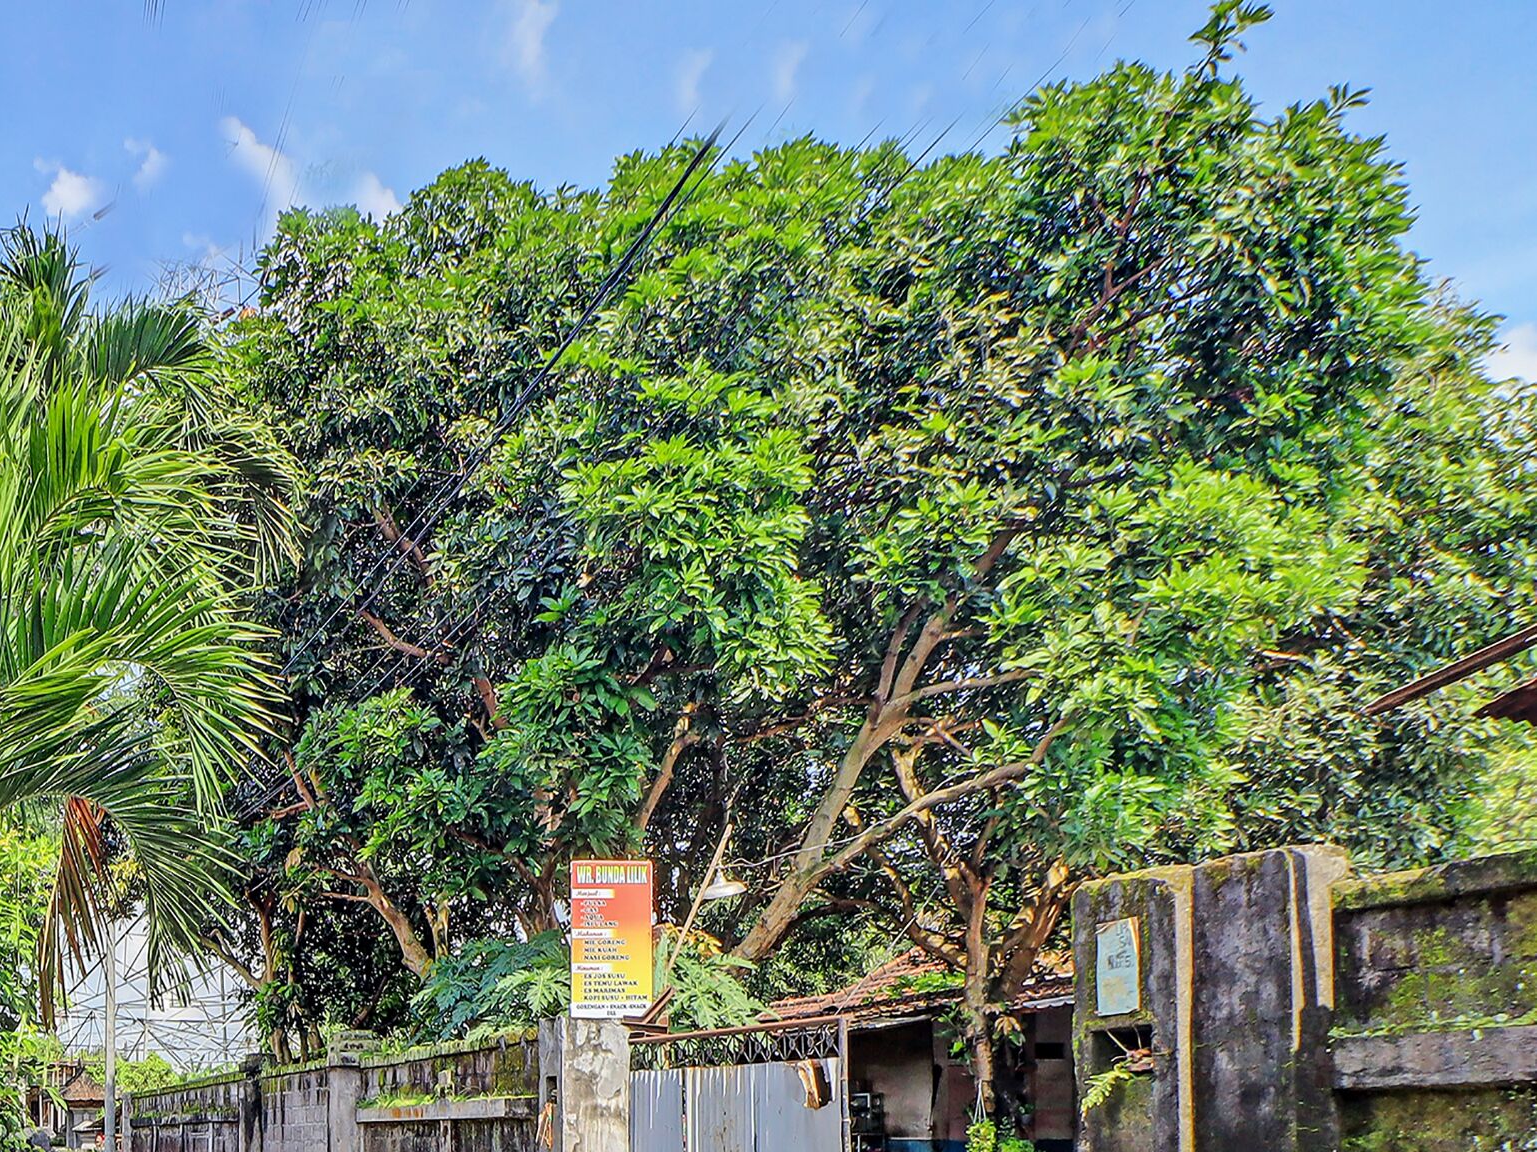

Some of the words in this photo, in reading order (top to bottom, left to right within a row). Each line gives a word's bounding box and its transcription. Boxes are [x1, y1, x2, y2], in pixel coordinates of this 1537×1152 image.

[576, 865, 594, 884] WR.
[595, 865, 625, 884] BUNDA
[626, 865, 648, 884] LILIK
